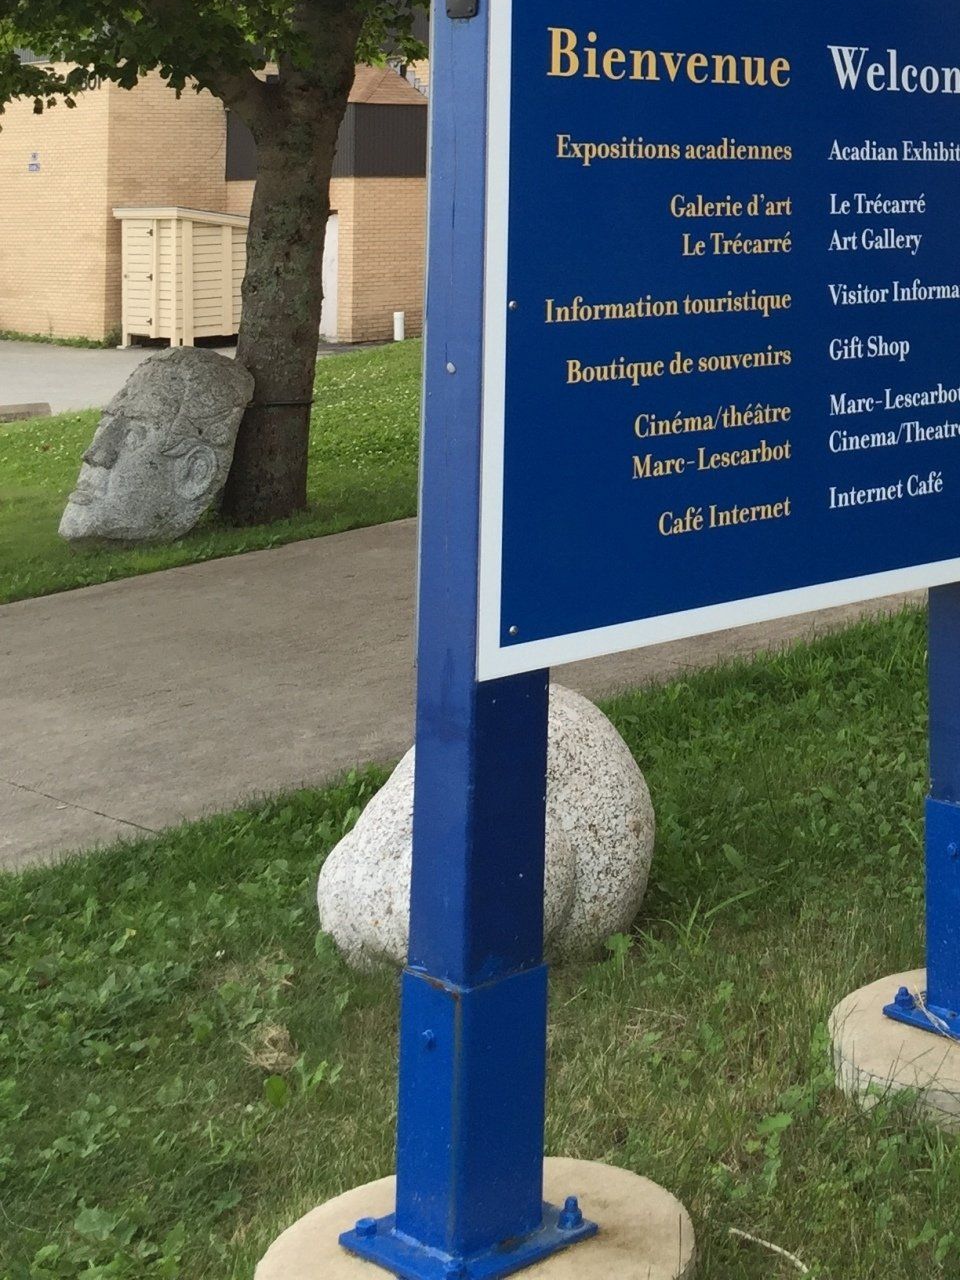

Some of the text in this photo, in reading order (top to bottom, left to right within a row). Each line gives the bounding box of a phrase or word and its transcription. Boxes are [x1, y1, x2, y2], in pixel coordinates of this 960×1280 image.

[546, 27, 791, 87] Bienvenue
[556, 134, 793, 167] Expositions acadiennes
[828, 139, 899, 161] Acadian
[670, 193, 792, 218] Galerie d'art
[829, 192, 926, 215] Le Trécarré
[682, 232, 792, 256] Le Trécarré
[828, 228, 922, 255] Art Gallery
[545, 290, 792, 324] Information touristique
[828, 283, 889, 306] Visitor
[829, 335, 910, 362] Gift Shop
[566, 344, 792, 387] Boutique de souvenirs
[634, 403, 791, 439] Cinéma/théâtre
[632, 439, 792, 479] Marc-Lescarbot
[829, 471, 943, 509] Internet Café
[658, 497, 791, 536] Café Internet
